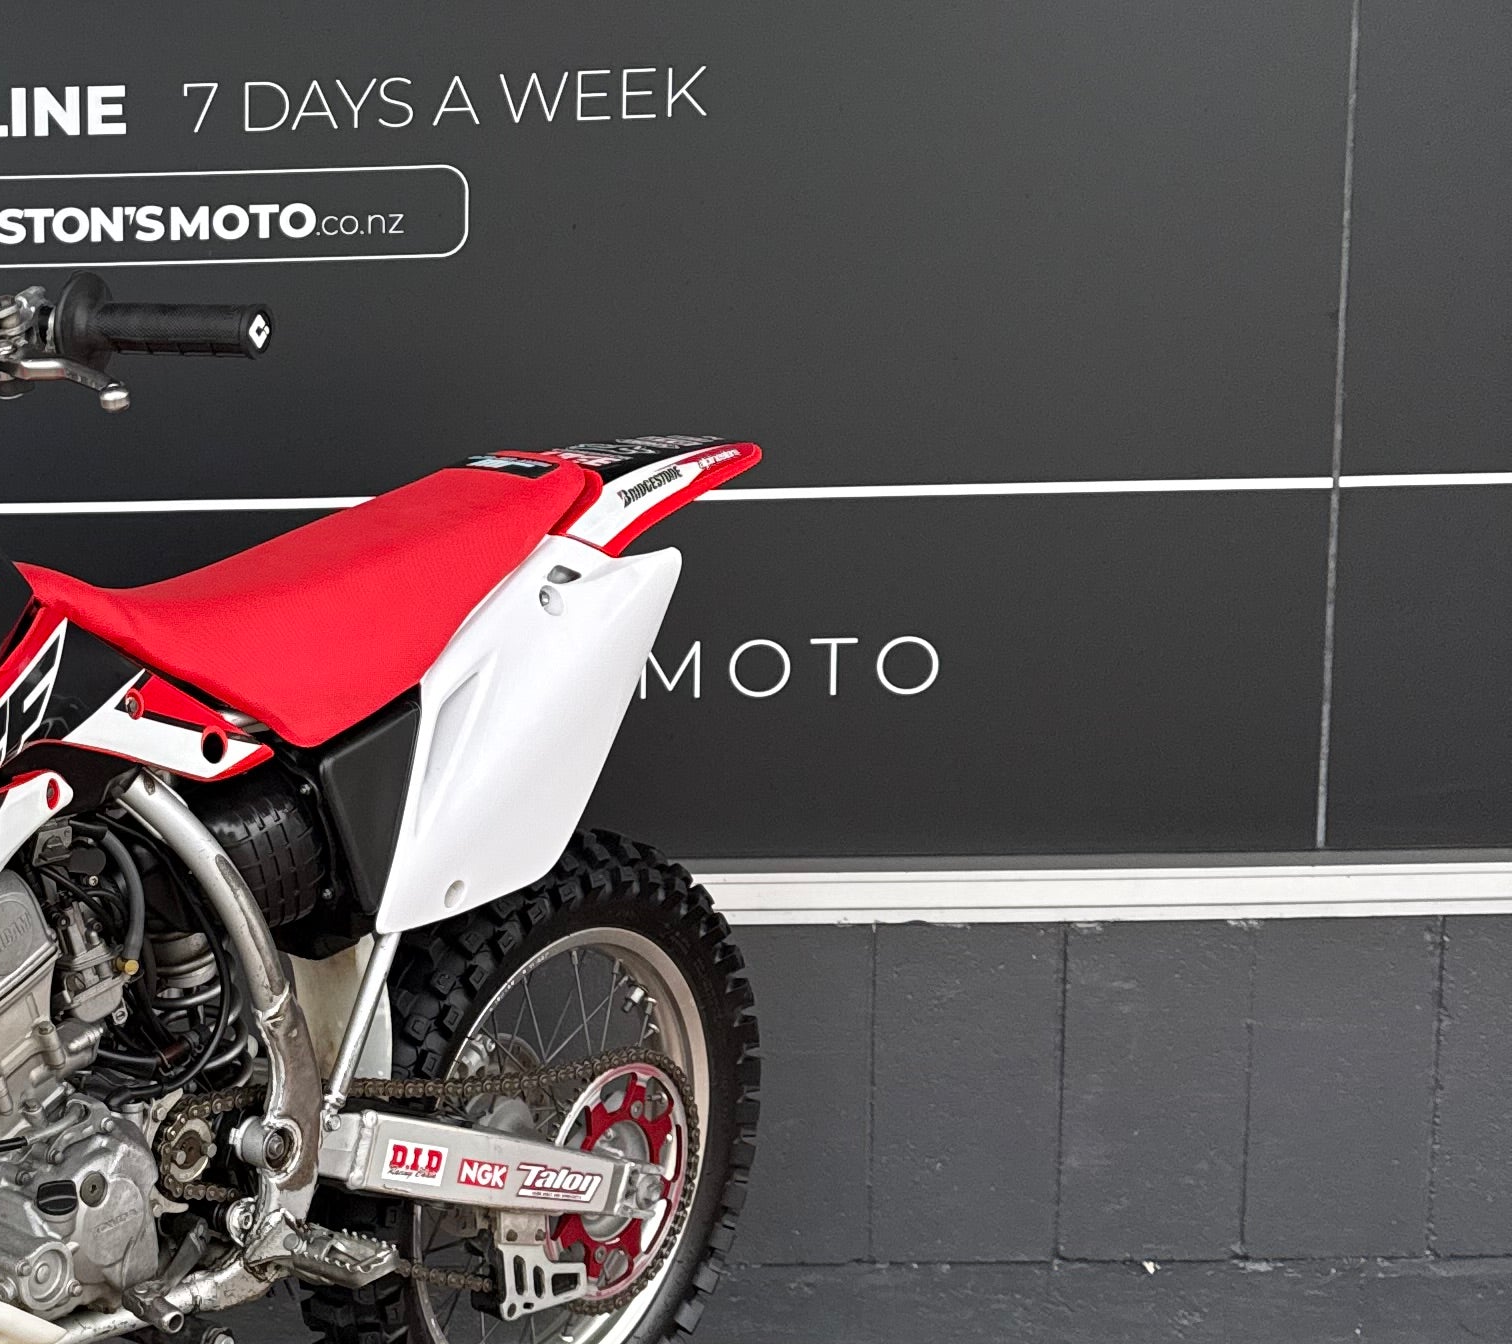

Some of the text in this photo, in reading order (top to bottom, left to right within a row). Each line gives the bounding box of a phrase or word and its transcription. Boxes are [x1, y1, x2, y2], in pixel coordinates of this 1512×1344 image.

[182, 81, 219, 133] 7
[244, 76, 414, 132] DAYS
[432, 74, 480, 126] A
[499, 65, 707, 124] WEEK
[617, 465, 683, 508] BRIDGESTONE
[640, 636, 939, 699] MOTO
[460, 1161, 504, 1188] NGK
[518, 1163, 603, 1194] Talon
